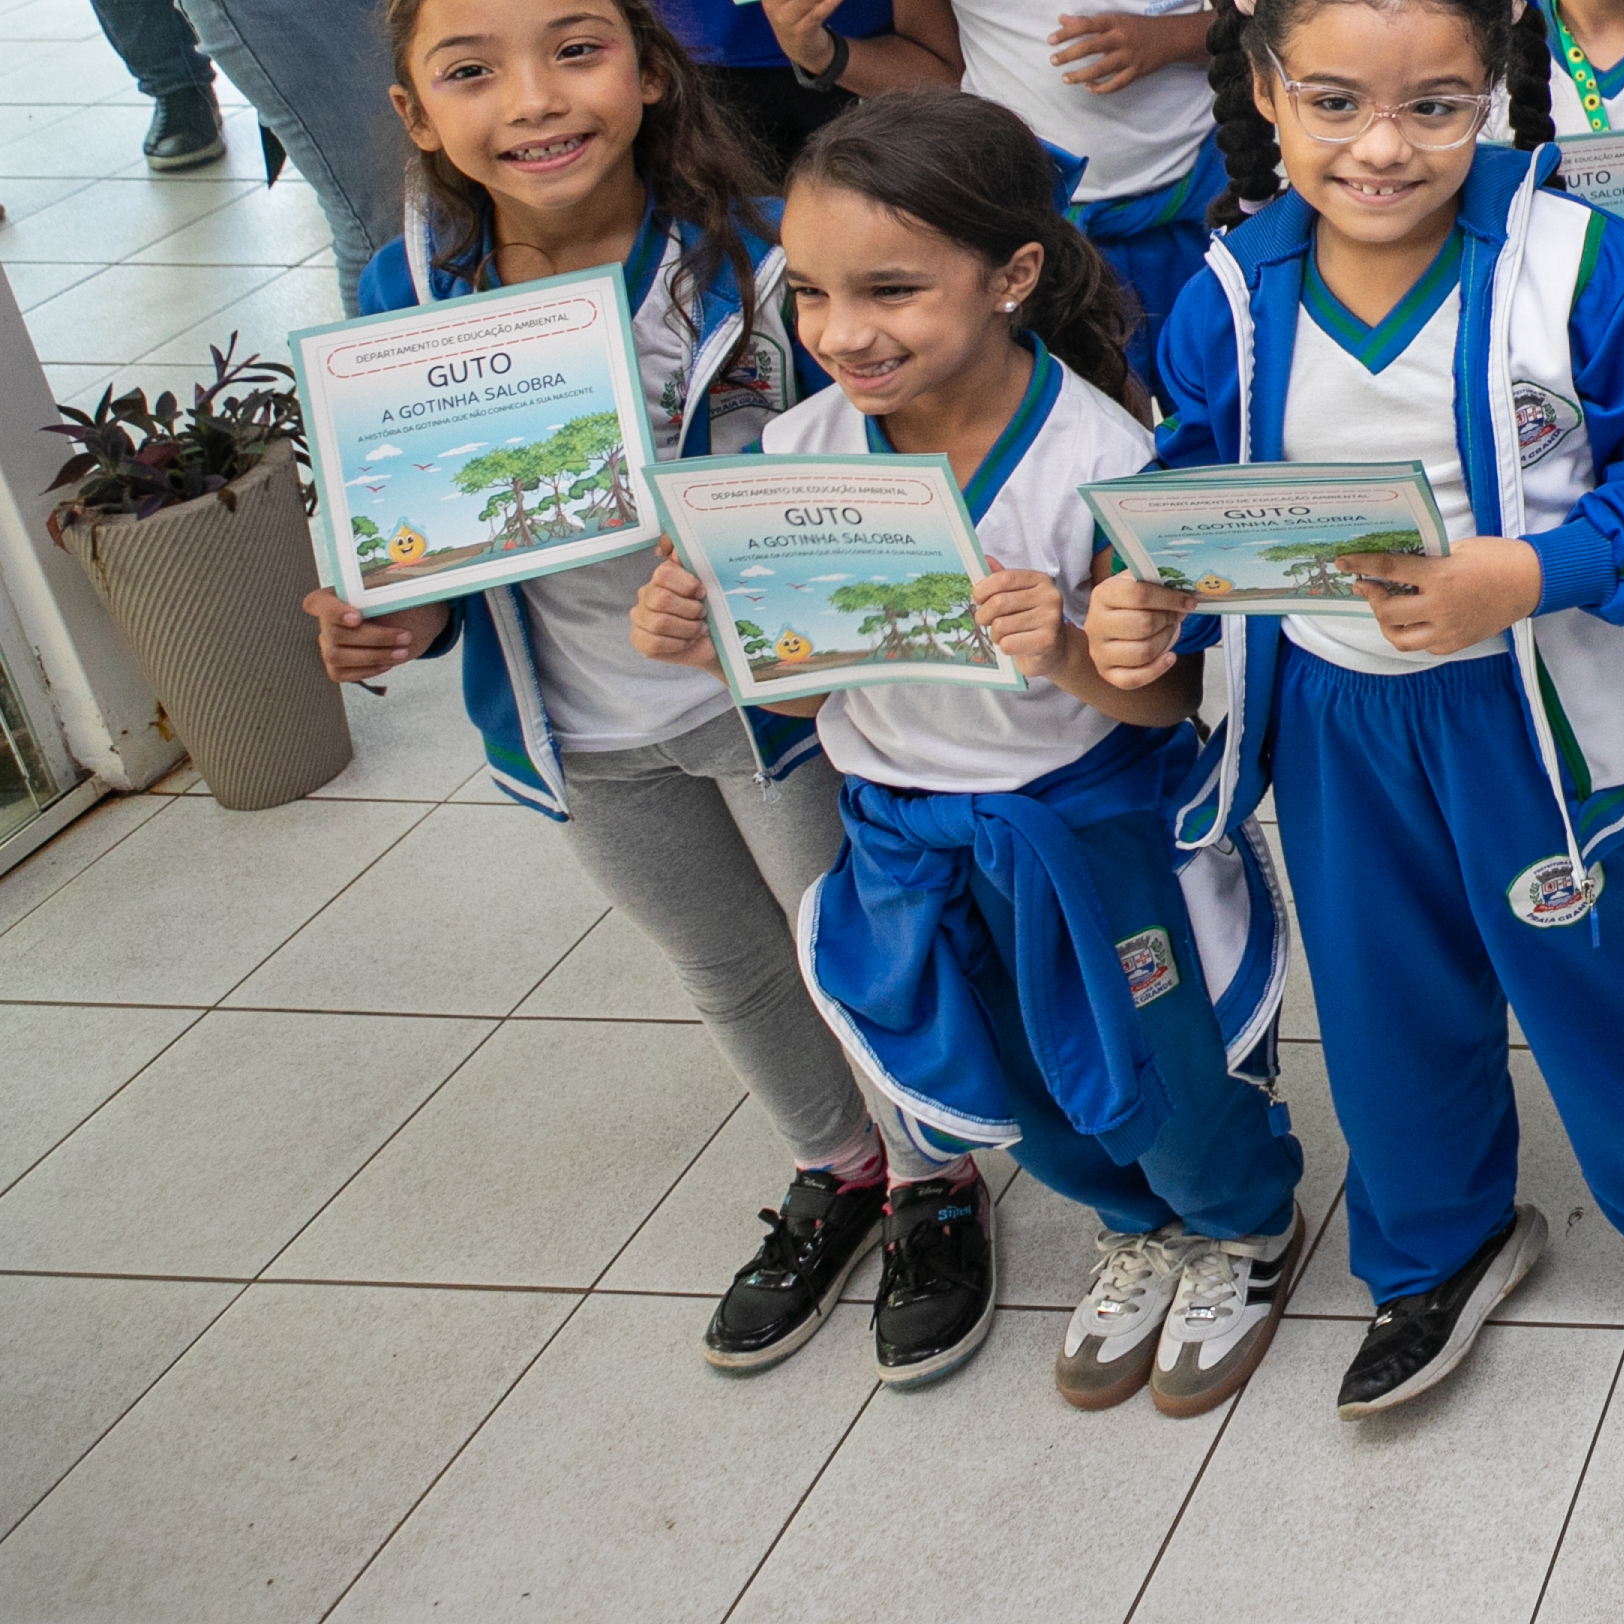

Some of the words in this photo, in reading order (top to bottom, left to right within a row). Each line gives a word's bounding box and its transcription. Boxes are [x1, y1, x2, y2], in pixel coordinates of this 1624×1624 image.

[1574, 153, 1613, 164] EDUCAÇÃO
[1568, 170, 1611, 189] UTO
[356, 340, 439, 364] DEPARTAMENTO
[441, 336, 454, 346] DE
[457, 324, 512, 343] EDUCAÇÃO
[515, 314, 568, 330] AMBIENTAL
[428, 353, 511, 387] GUTO
[382, 409, 394, 423] A
[399, 392, 479, 419] GOTINHA
[485, 373, 565, 401] SALOBRA
[709, 488, 788, 499] DEPARTAMENTO
[804, 485, 855, 495] EDUCAÇÃO
[785, 508, 863, 526] GUTO
[1224, 507, 1310, 519] GUTO
[1198, 521, 1278, 530] GOTINHA
[1284, 516, 1366, 526] SALOBRA
[749, 538, 760, 548] A
[764, 534, 838, 547] GOTINHA
[842, 534, 916, 544] SALOBRA
[1526, 912, 1556, 923] PRAIA
